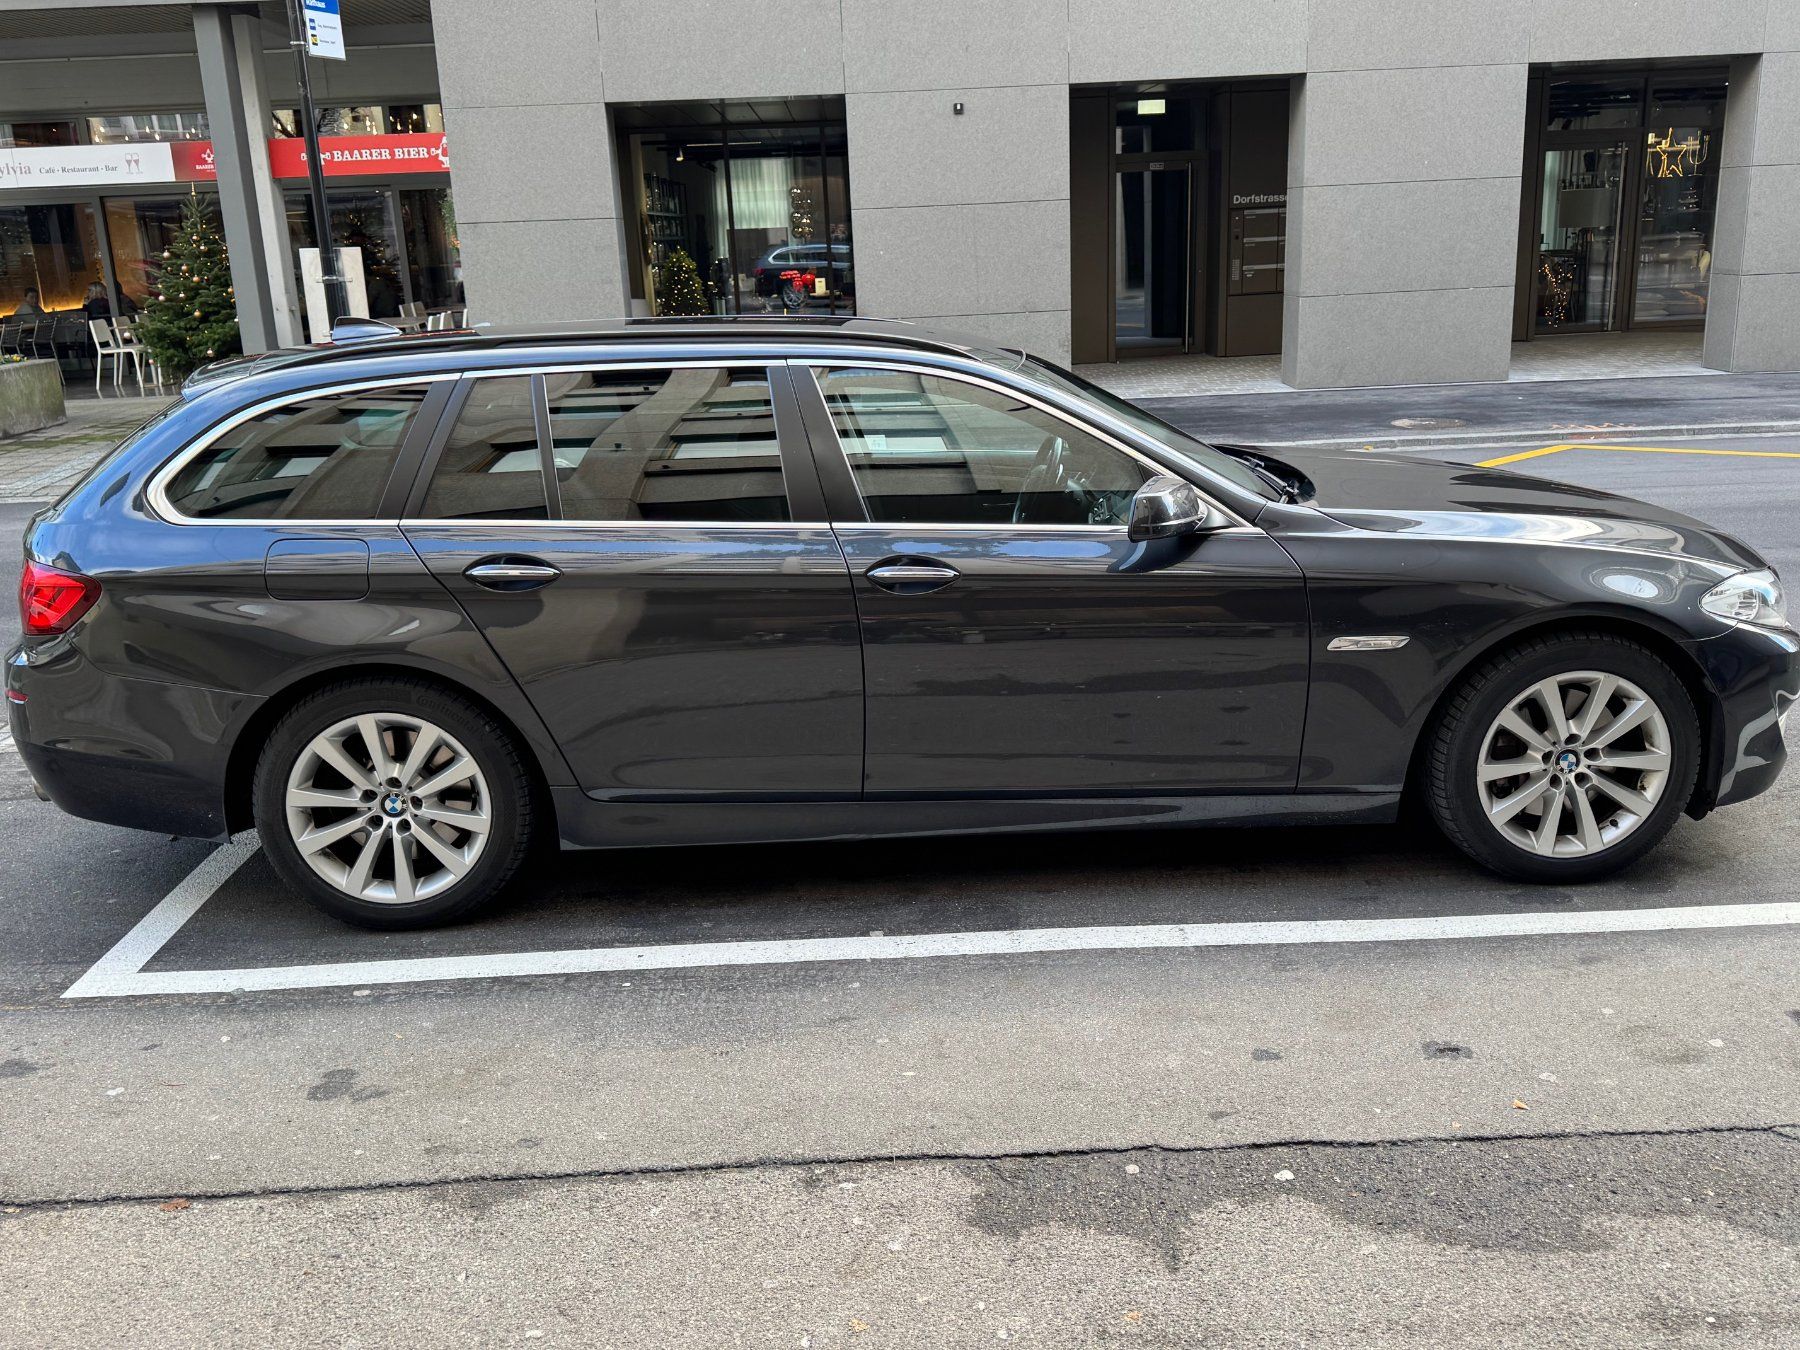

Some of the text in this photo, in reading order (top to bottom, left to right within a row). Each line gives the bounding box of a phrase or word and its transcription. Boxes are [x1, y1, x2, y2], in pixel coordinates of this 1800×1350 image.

[333, 147, 429, 162] BAARER BIER
[39, 164, 118, 174] Café Restaurant Bar
